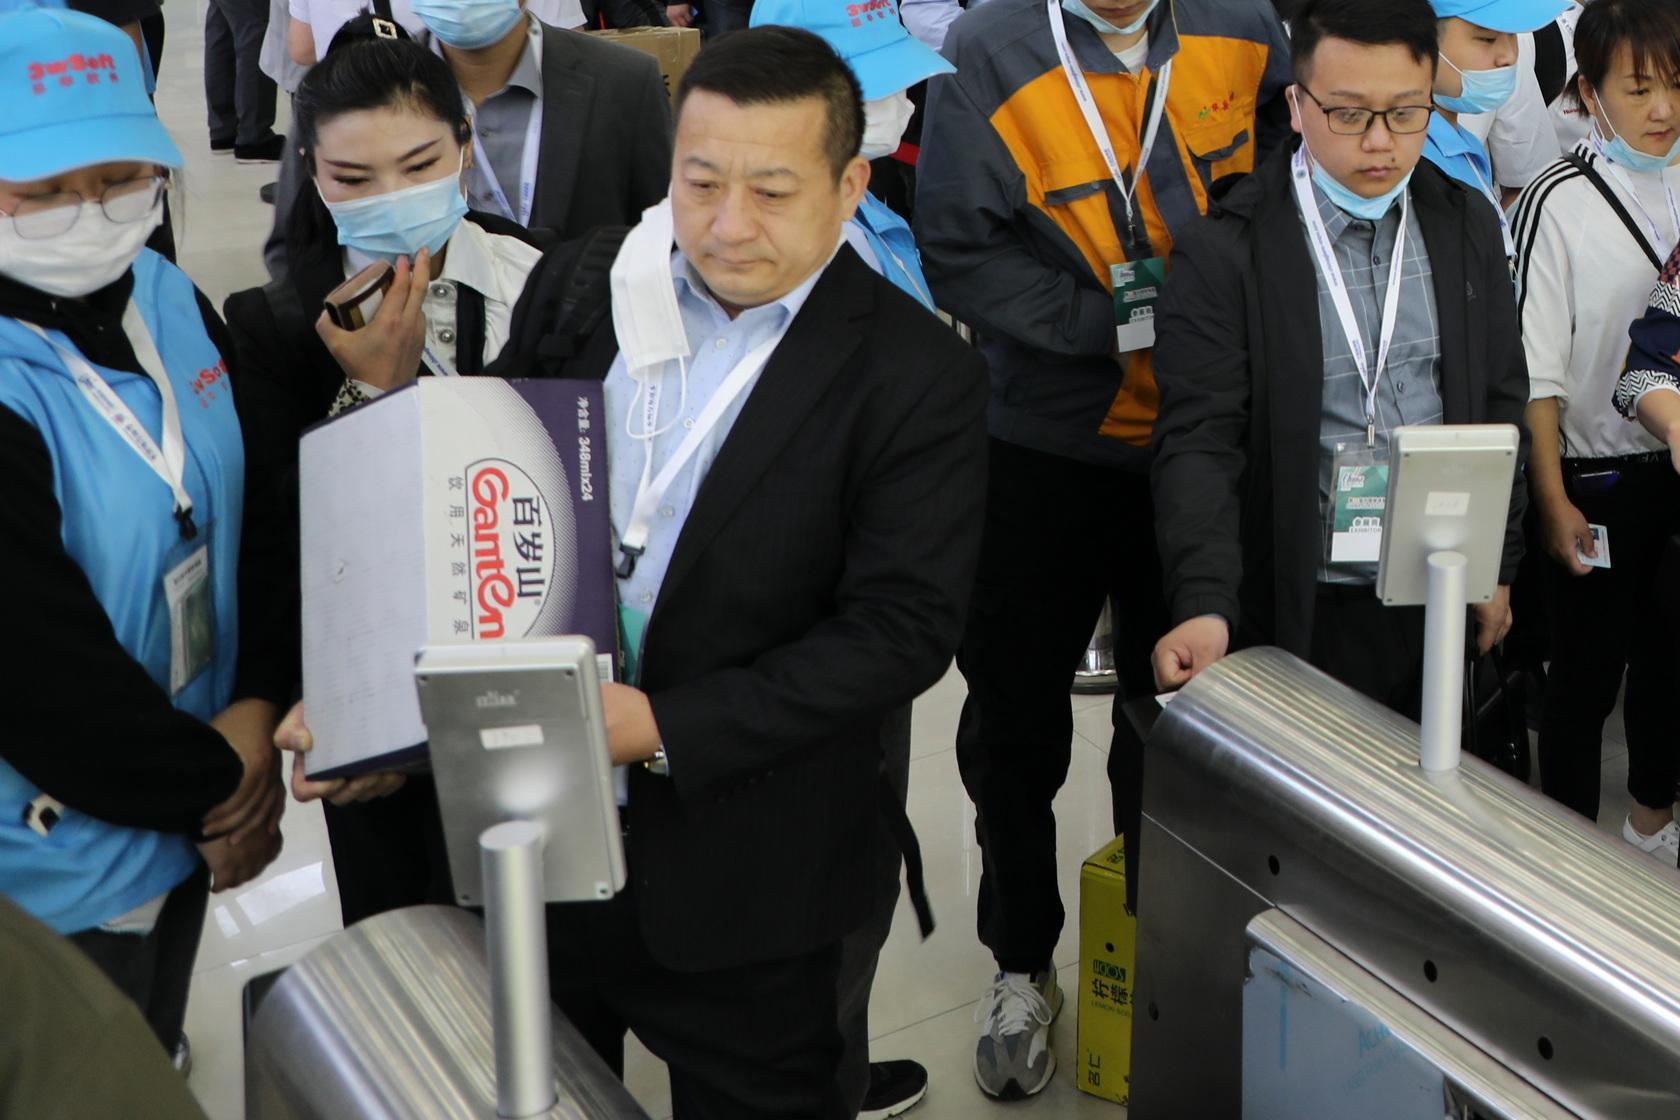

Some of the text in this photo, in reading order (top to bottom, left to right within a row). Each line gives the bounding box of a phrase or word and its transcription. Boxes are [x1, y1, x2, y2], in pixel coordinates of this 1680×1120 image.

[511, 496, 546, 599] 百岁山
[1091, 978, 1136, 1006] 柠檬
